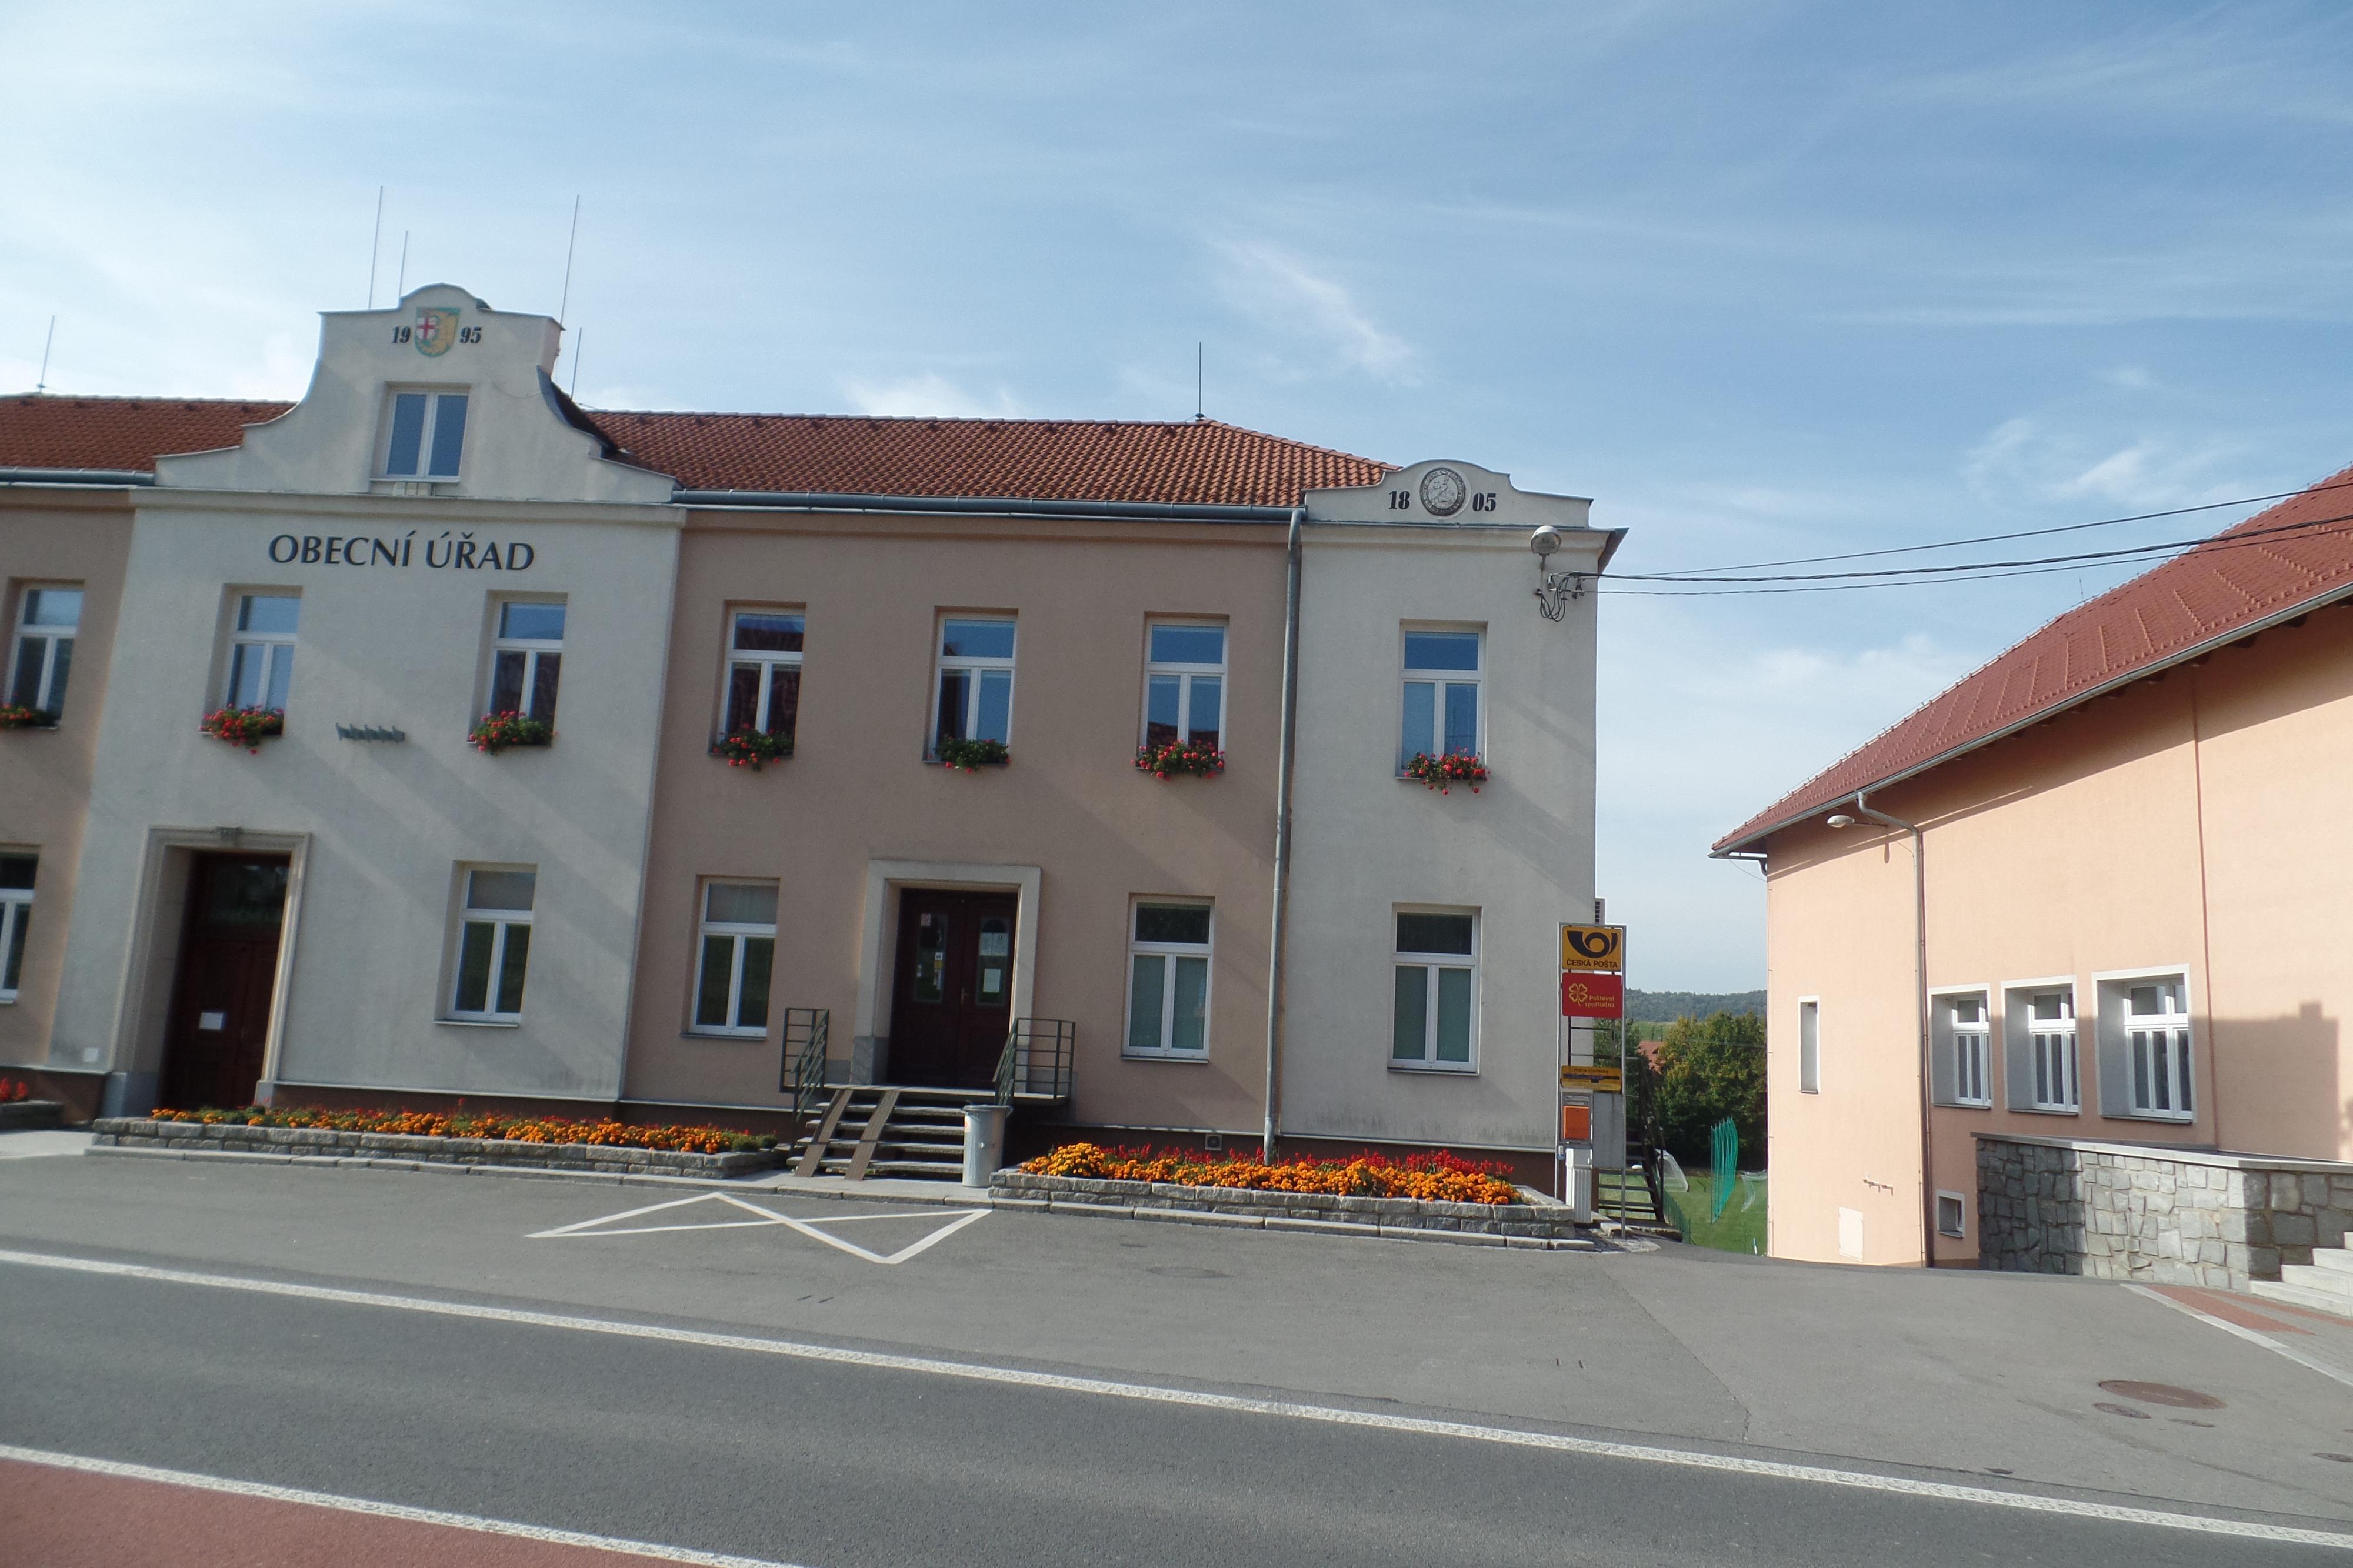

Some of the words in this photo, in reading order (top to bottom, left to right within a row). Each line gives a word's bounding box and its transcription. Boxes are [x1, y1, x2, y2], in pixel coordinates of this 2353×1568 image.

[391, 326, 411, 344] 19
[459, 326, 481, 344] 95
[1388, 491, 1410, 510] 18
[1472, 492, 1497, 512] 05
[268, 530, 417, 566] OBECNÍ
[426, 531, 535, 571] ÚŘAD
[1567, 958, 1591, 966] ČESKÁ
